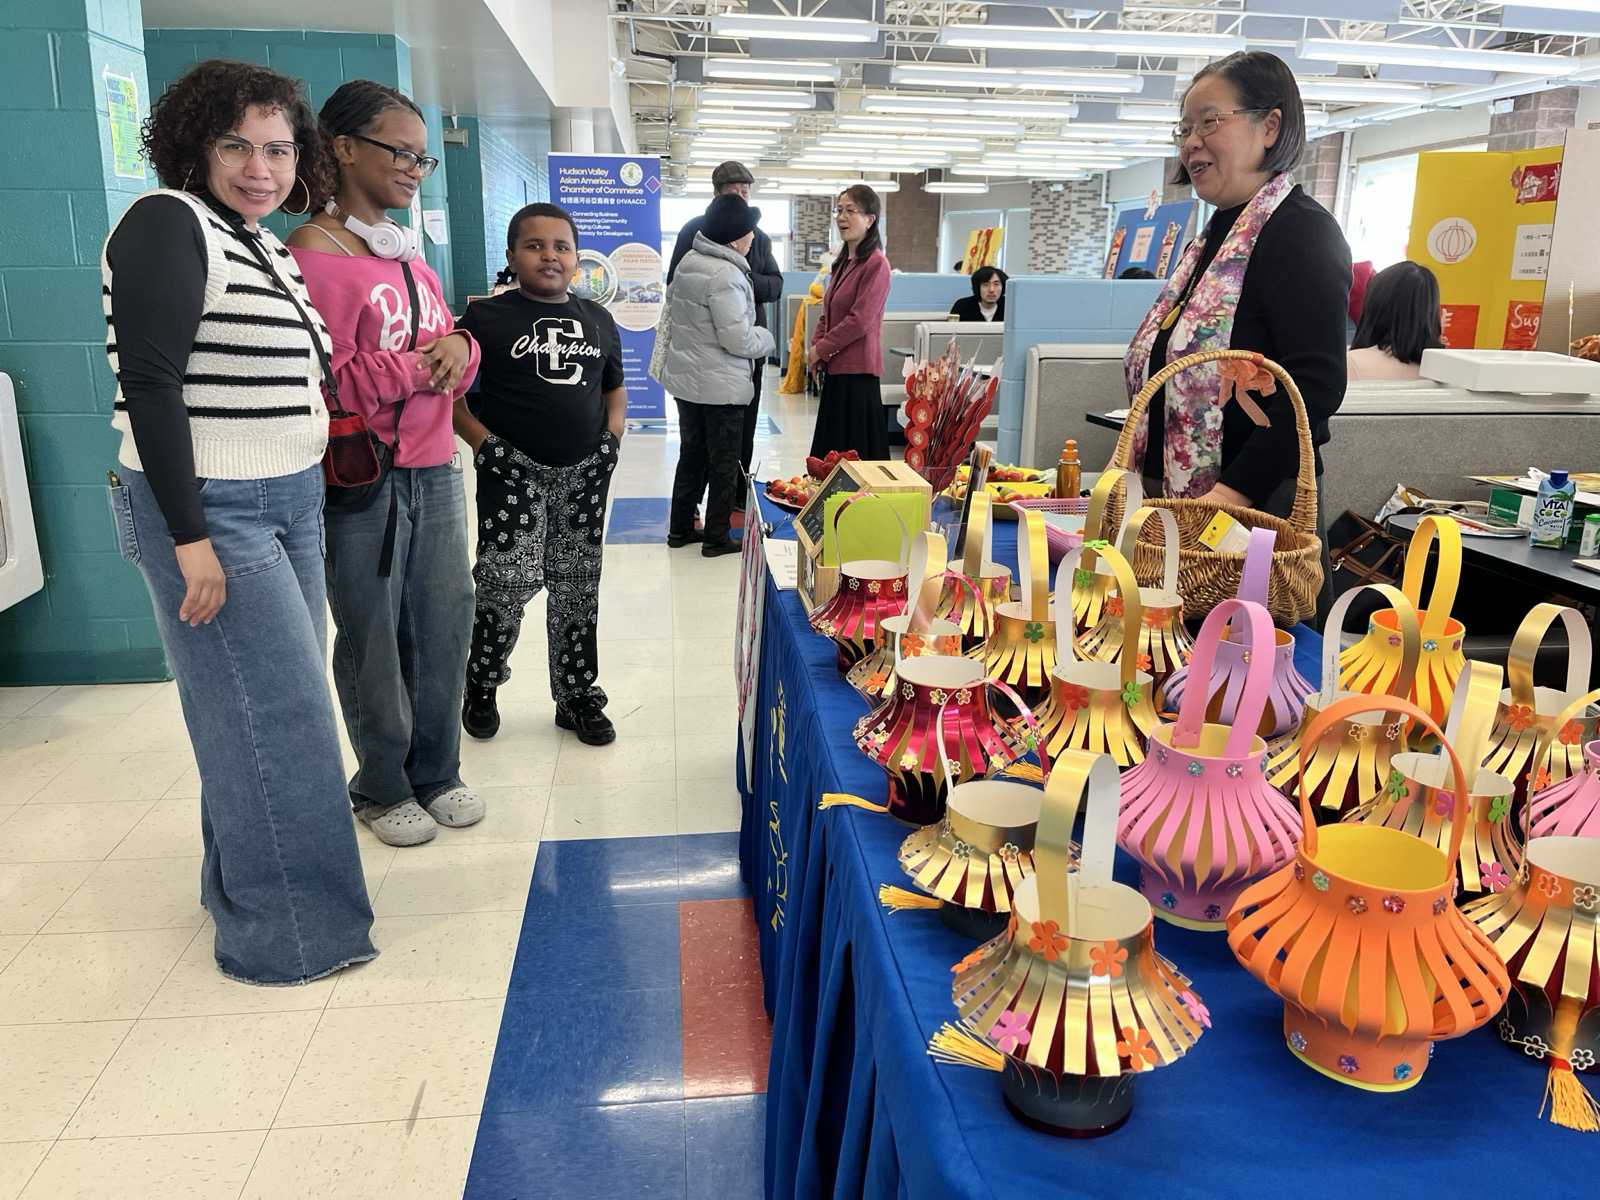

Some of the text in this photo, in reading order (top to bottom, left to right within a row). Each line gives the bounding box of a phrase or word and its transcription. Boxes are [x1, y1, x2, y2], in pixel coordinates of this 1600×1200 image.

[588, 168, 609, 177] Valley
[560, 185, 595, 193] Chamber
[511, 335, 601, 359] Champion
[1543, 499, 1565, 510] VITA
[1539, 509, 1567, 518] COCO
